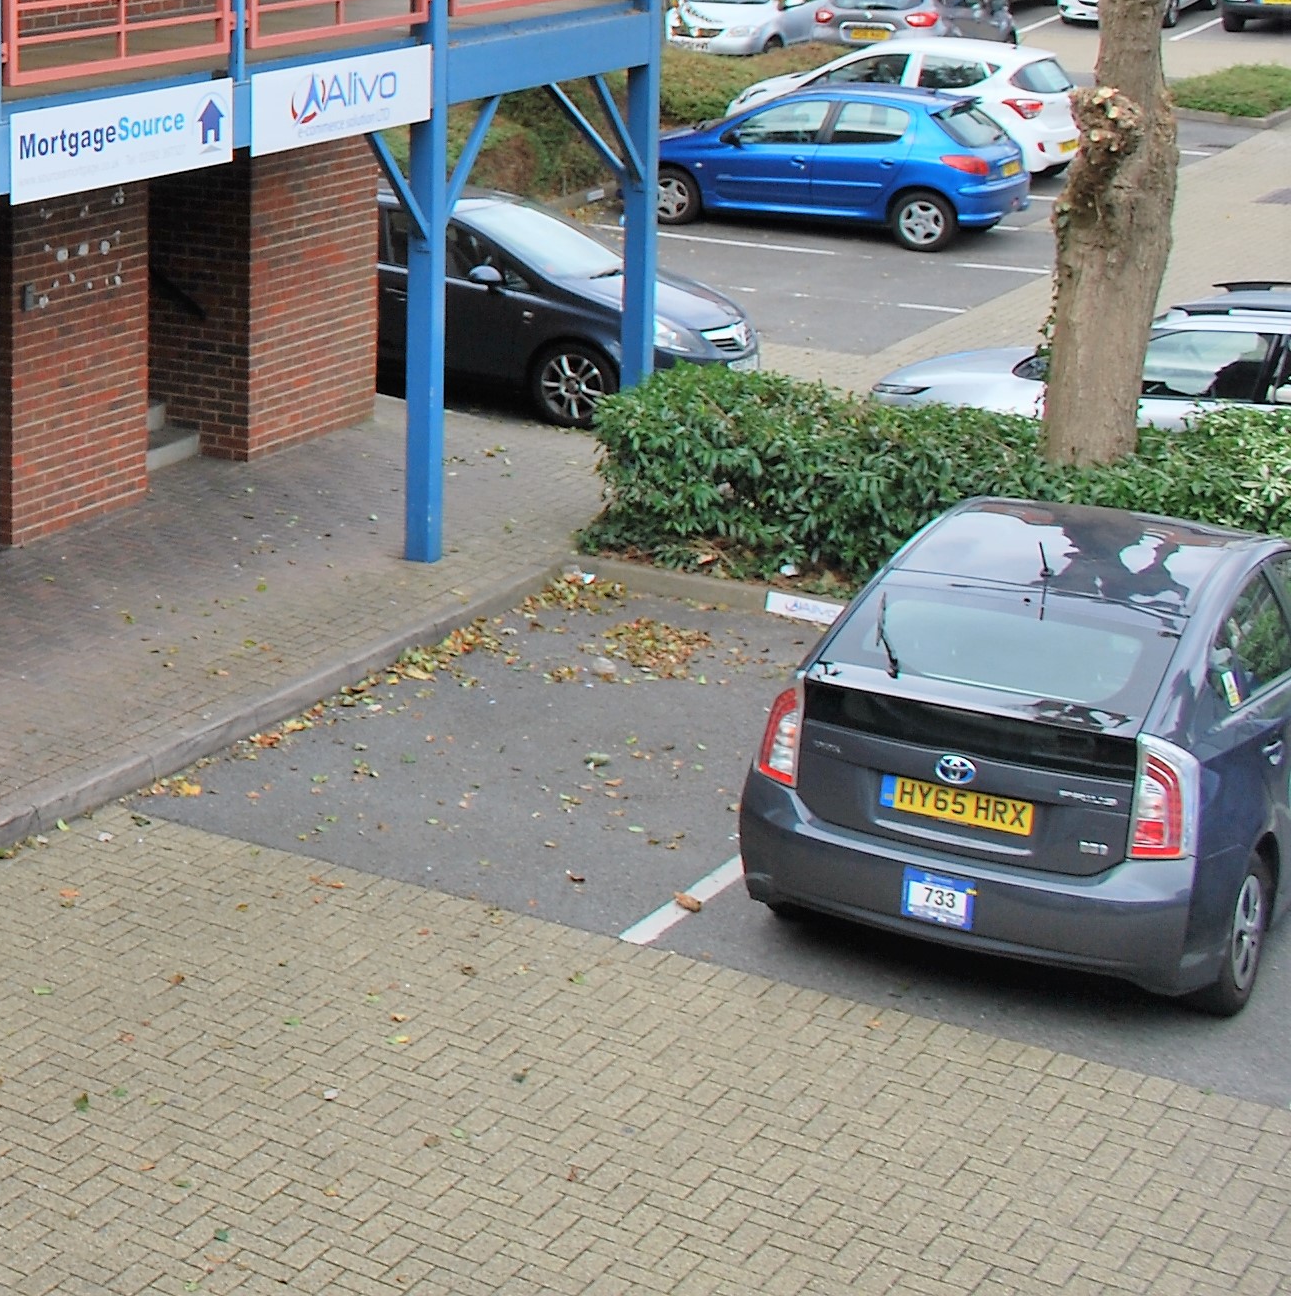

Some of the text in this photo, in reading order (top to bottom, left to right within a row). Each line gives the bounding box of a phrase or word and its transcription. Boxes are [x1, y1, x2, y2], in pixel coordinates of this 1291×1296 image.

[19, 113, 185, 160] MortgageSource
[899, 782, 1027, 828] HY65 HRX
[924, 886, 955, 908] 733
